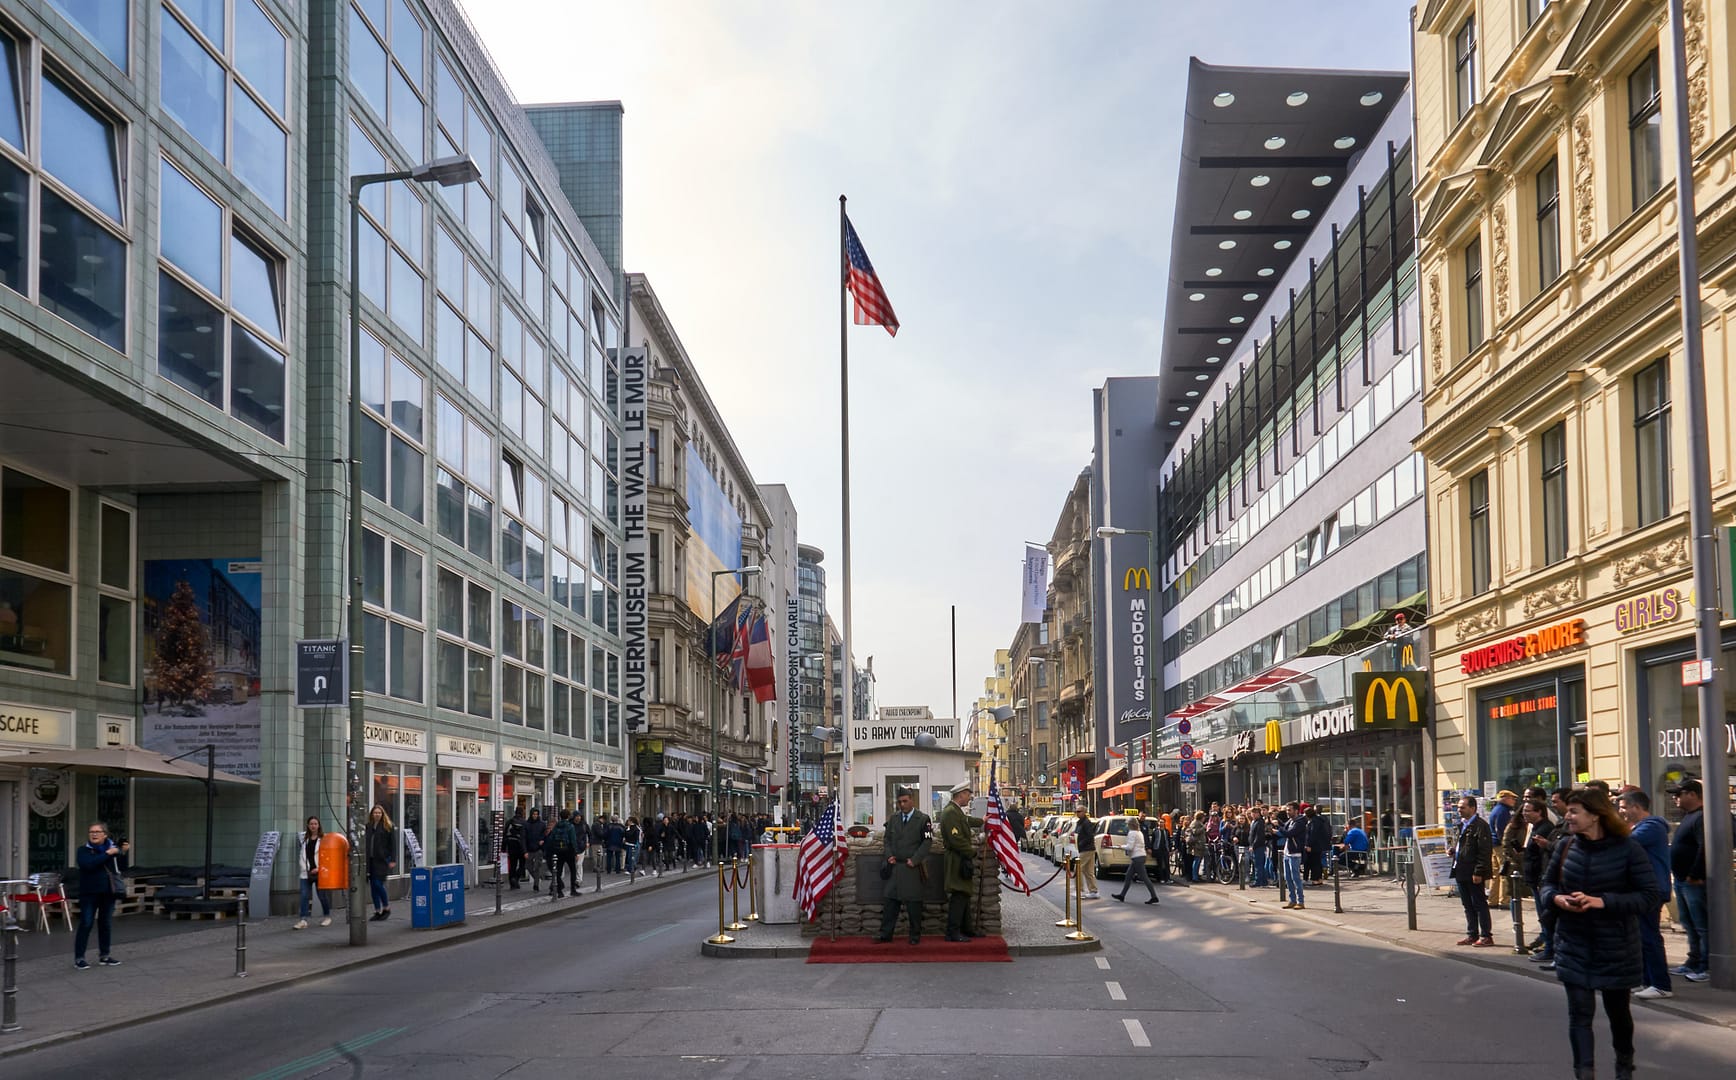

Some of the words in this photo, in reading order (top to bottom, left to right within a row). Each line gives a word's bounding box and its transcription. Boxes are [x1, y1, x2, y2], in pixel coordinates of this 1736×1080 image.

[625, 354, 644, 404] MUR
[625, 409, 644, 431] LE
[625, 441, 645, 499] WALL
[625, 504, 645, 541] THE
[788, 599, 798, 646] CHARLIE
[1615, 588, 1678, 631] GIRLS
[626, 552, 645, 725] MAUERMUSEUM
[1461, 637, 1526, 674] SOUVENIRS
[1525, 634, 1539, 657] &
[1538, 618, 1584, 653] MORE
[788, 650, 798, 722] CHECKPOINT
[899, 708, 923, 717] CHECKPOINT
[394, 731, 418, 747] CHARLIE
[449, 740, 462, 752] WALL
[463, 742, 482, 756] MUSEUM
[788, 726, 798, 745] AM
[854, 727, 868, 740] US
[871, 726, 897, 740] ARMY
[900, 725, 954, 740] CHECKPOINT
[788, 748, 798, 780] HAUS
